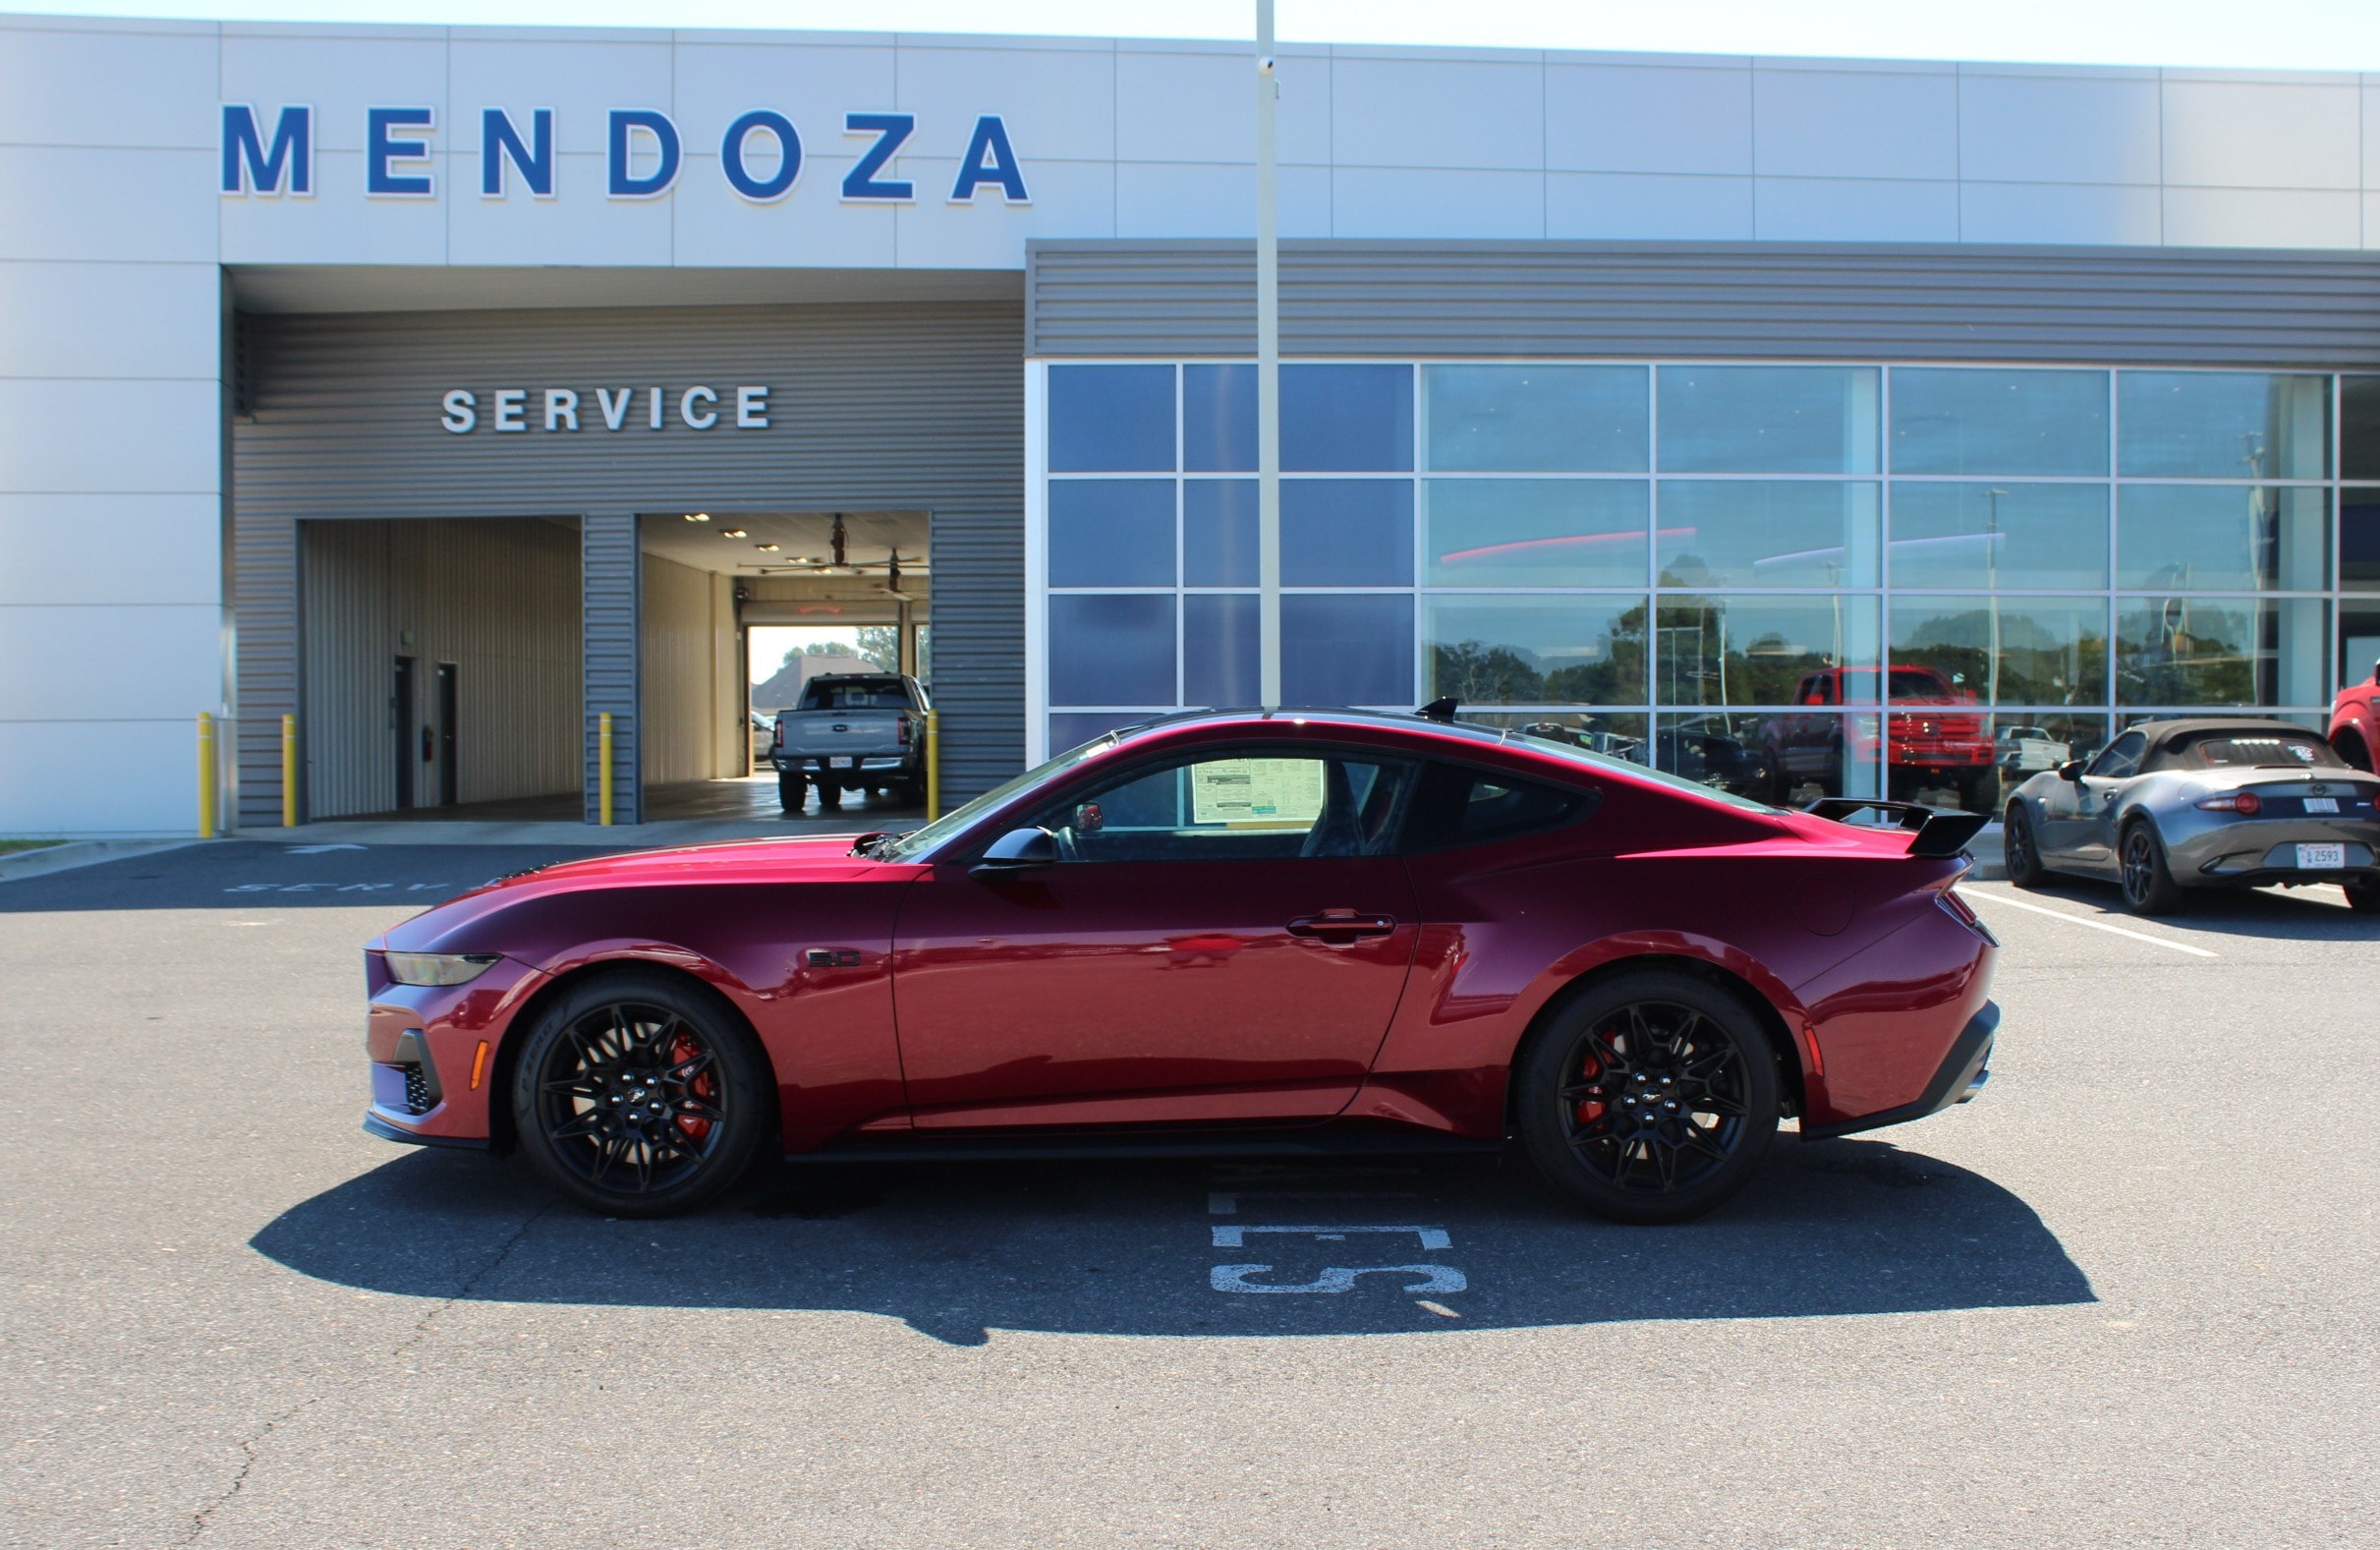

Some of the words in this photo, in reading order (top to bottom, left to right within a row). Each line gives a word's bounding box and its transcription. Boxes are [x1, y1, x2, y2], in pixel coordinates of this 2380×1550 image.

[220, 103, 1033, 205] MENDOZA
[439, 384, 772, 433] SERVICE
[2314, 849, 2340, 862] 2593
